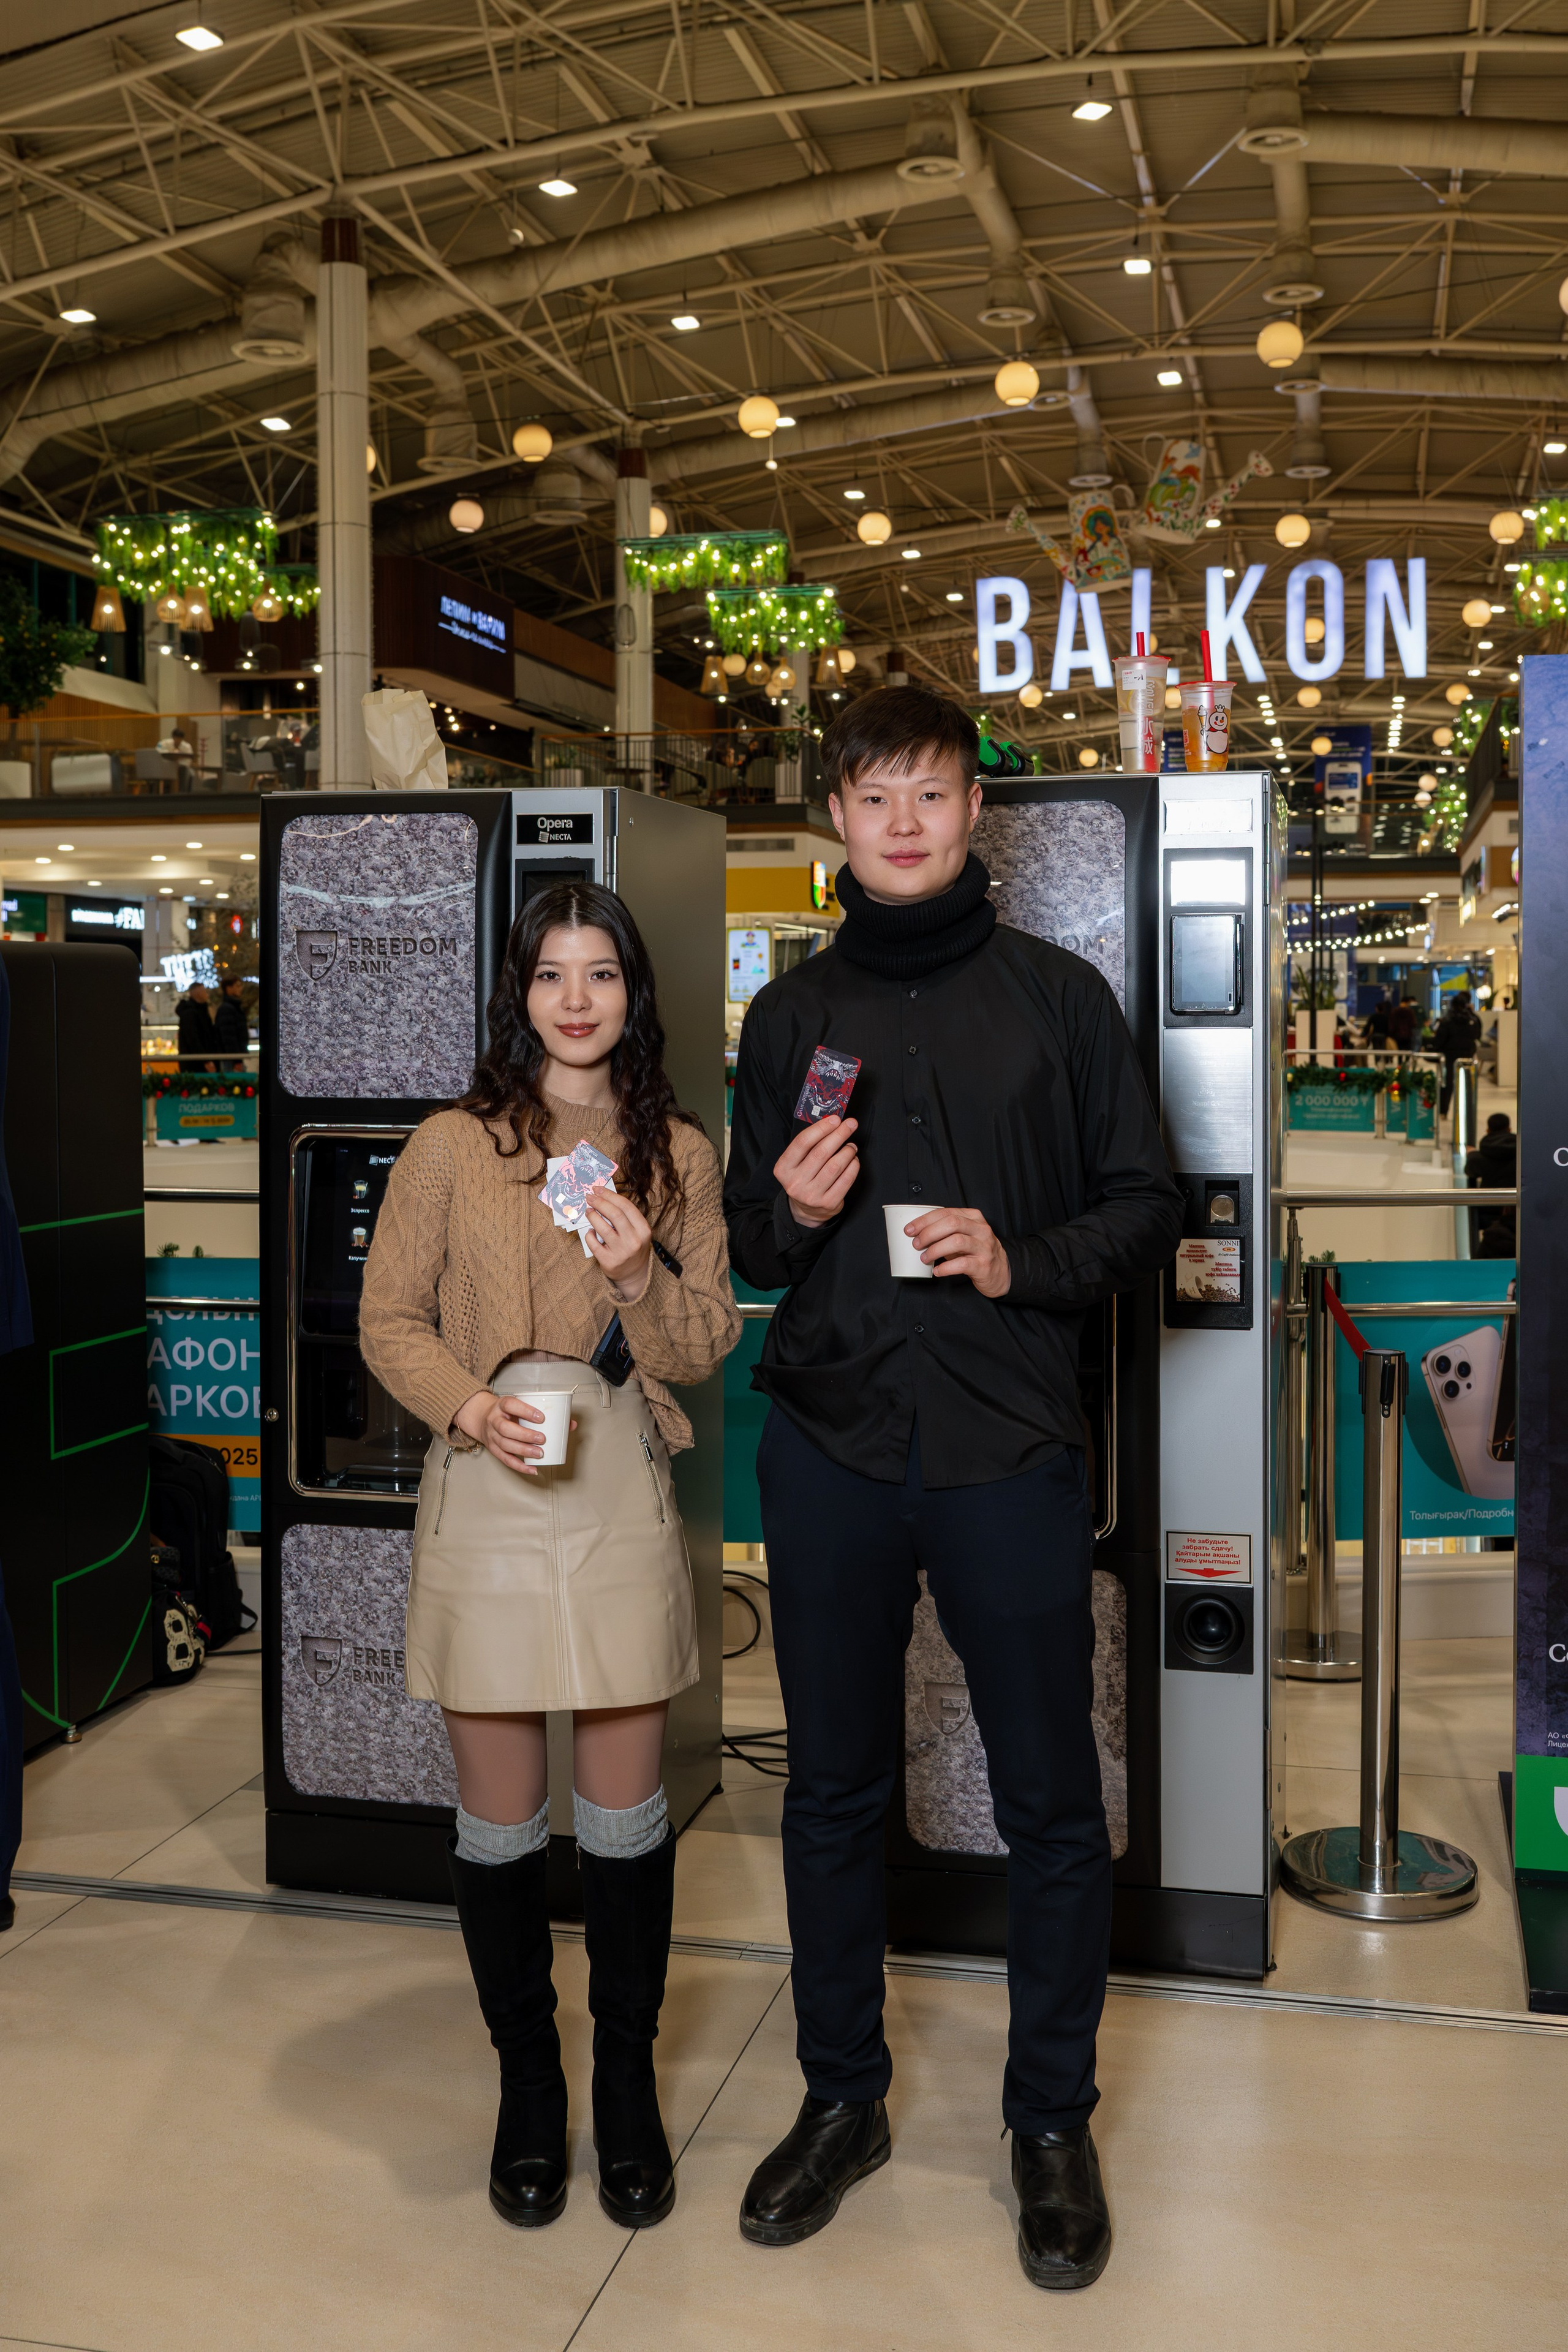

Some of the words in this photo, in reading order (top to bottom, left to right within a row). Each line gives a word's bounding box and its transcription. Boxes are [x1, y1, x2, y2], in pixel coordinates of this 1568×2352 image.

[976, 557, 1428, 693] BALKON
[537, 817, 573, 832] Opera
[348, 937, 456, 956] FREEDOM
[348, 960, 393, 974] BANK
[352, 1670, 397, 1685] BANK
